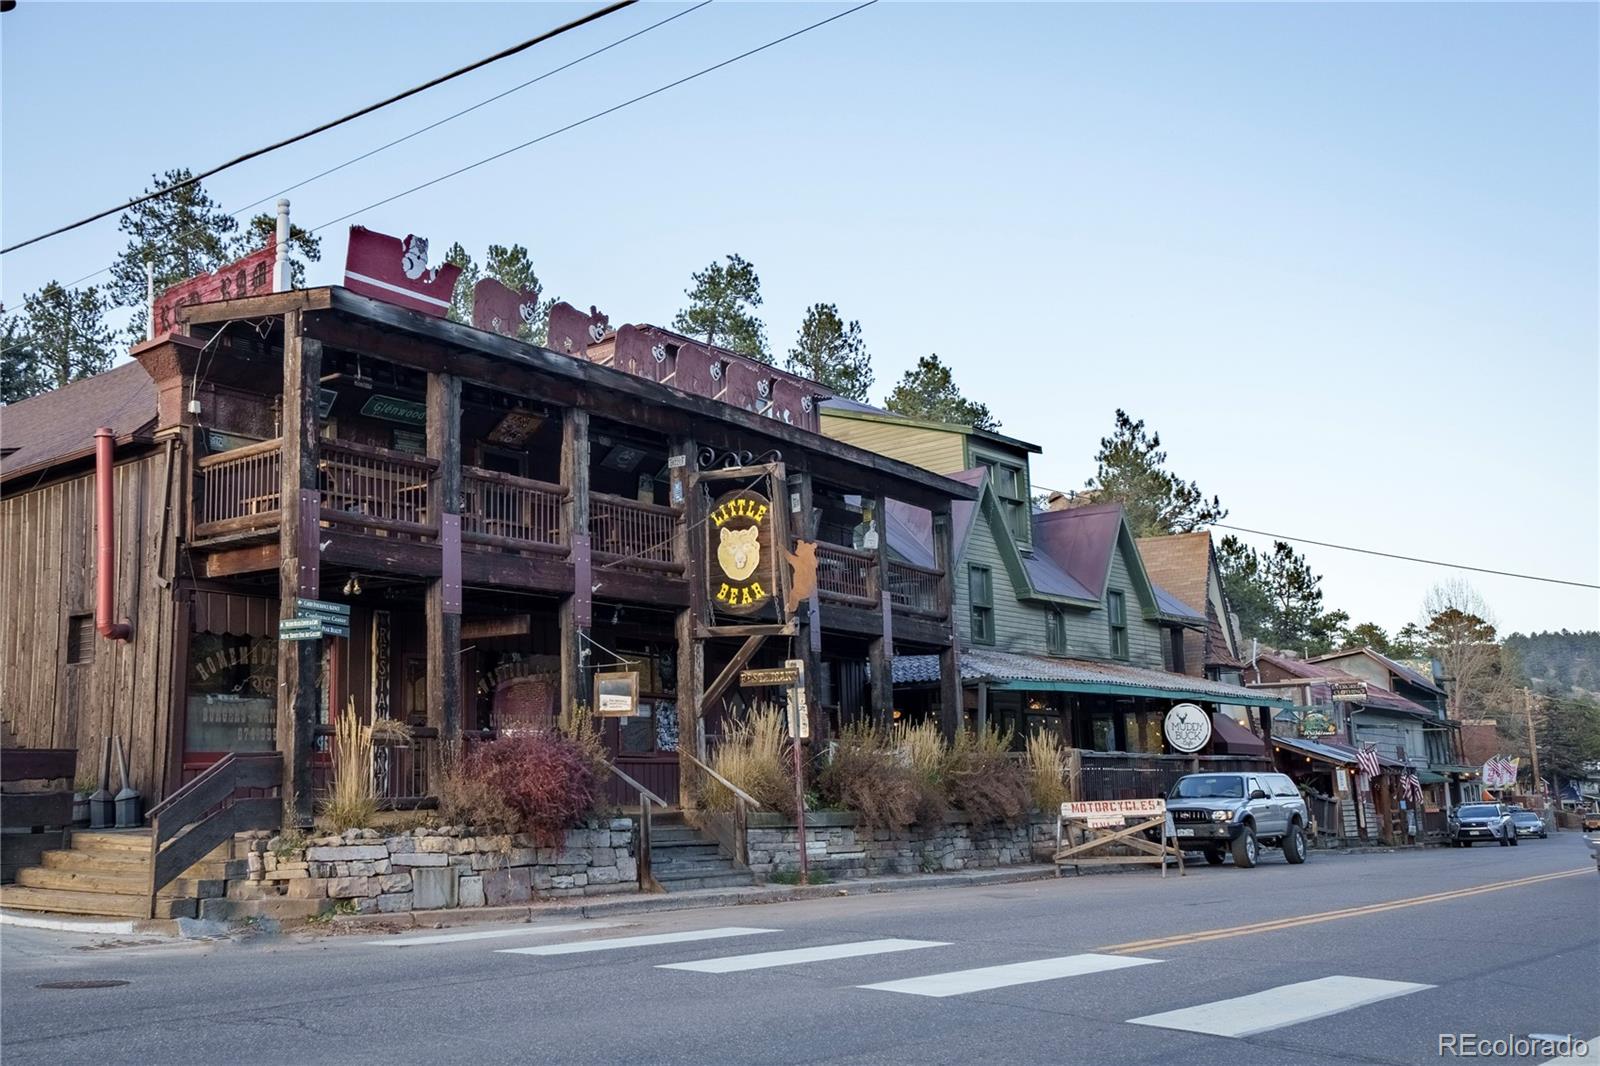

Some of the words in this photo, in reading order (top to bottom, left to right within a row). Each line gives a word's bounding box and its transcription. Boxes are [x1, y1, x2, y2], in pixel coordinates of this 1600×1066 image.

[373, 402, 425, 420] Glenwood
[710, 499, 768, 526] LITTLE
[716, 582, 766, 605] BEAR
[195, 646, 278, 681] HOMEMADE
[1171, 722, 1204, 731] MUDDY
[1175, 731, 1201, 741] BUCK
[1071, 800, 1156, 814] MOTORCYCLES
